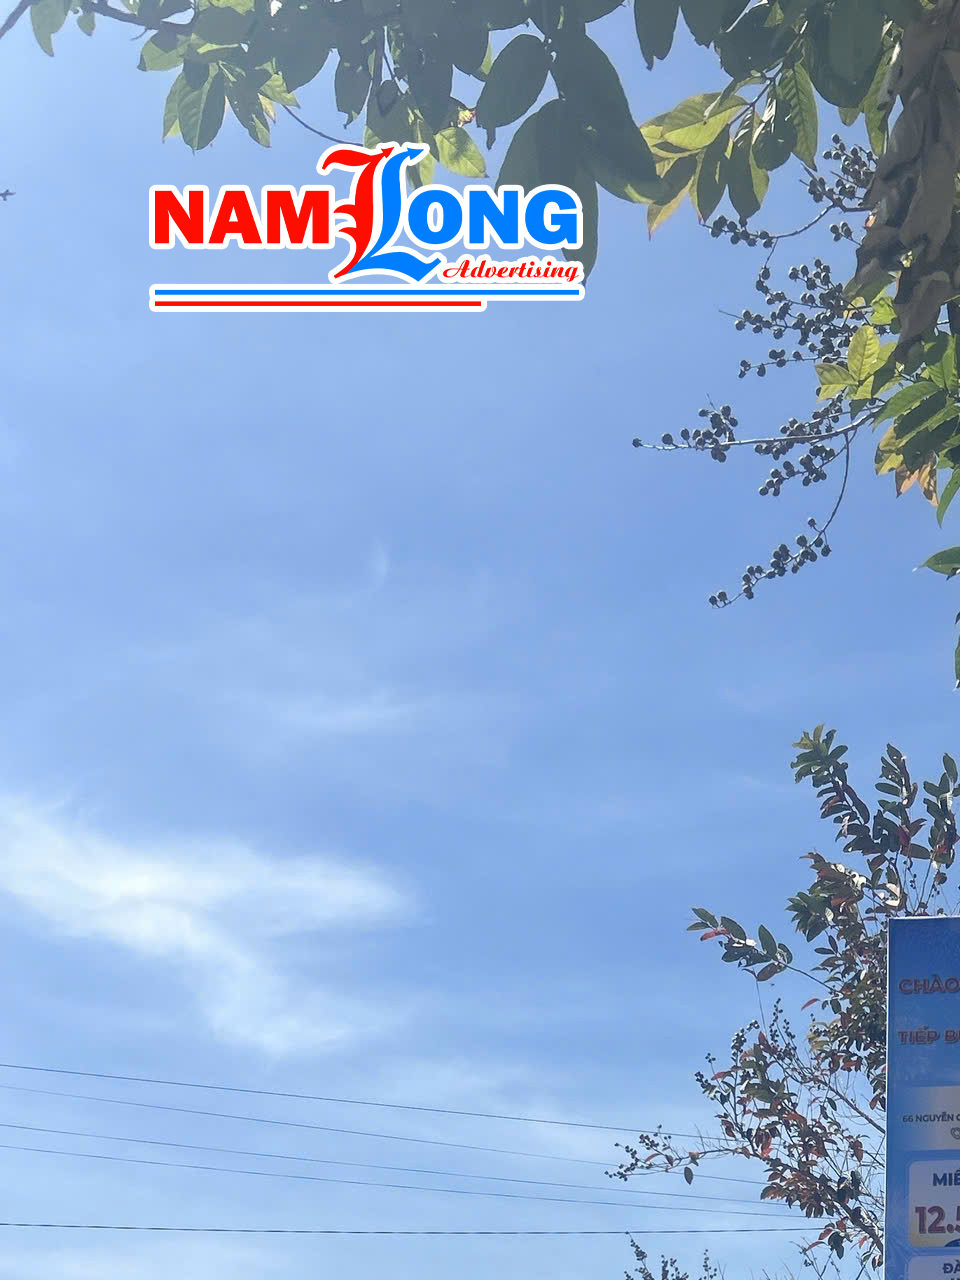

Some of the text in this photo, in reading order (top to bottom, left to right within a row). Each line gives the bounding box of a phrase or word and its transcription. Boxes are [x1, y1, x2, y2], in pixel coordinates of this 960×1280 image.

[898, 1025, 940, 1046] TIẾP
[902, 1115, 914, 1123] 66
[915, 1111, 954, 1123] NGUYỄN
